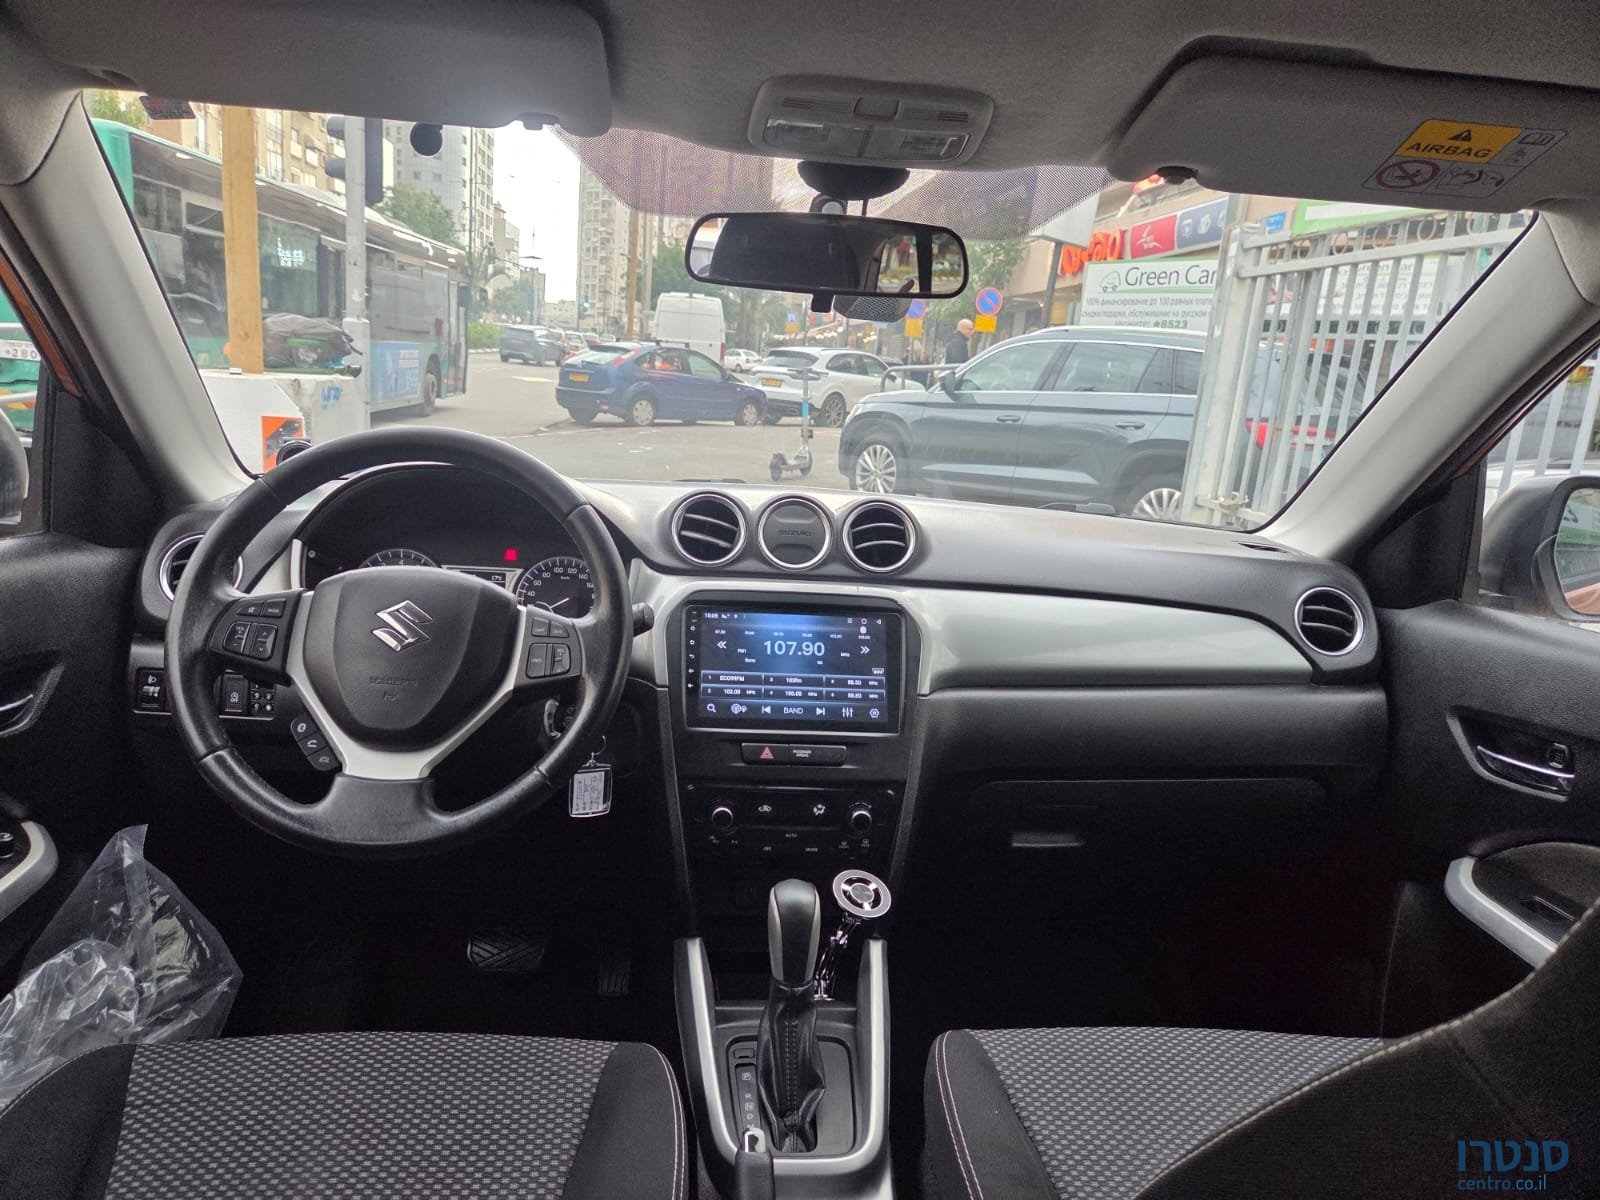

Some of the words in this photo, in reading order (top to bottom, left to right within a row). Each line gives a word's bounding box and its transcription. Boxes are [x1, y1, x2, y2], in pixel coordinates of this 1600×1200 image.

[1406, 143, 1492, 158] AIRBAG
[1125, 266, 1180, 286] Green
[1185, 264, 1216, 285] Car
[763, 640, 825, 656] 107.90
[783, 707, 804, 715] BAND
